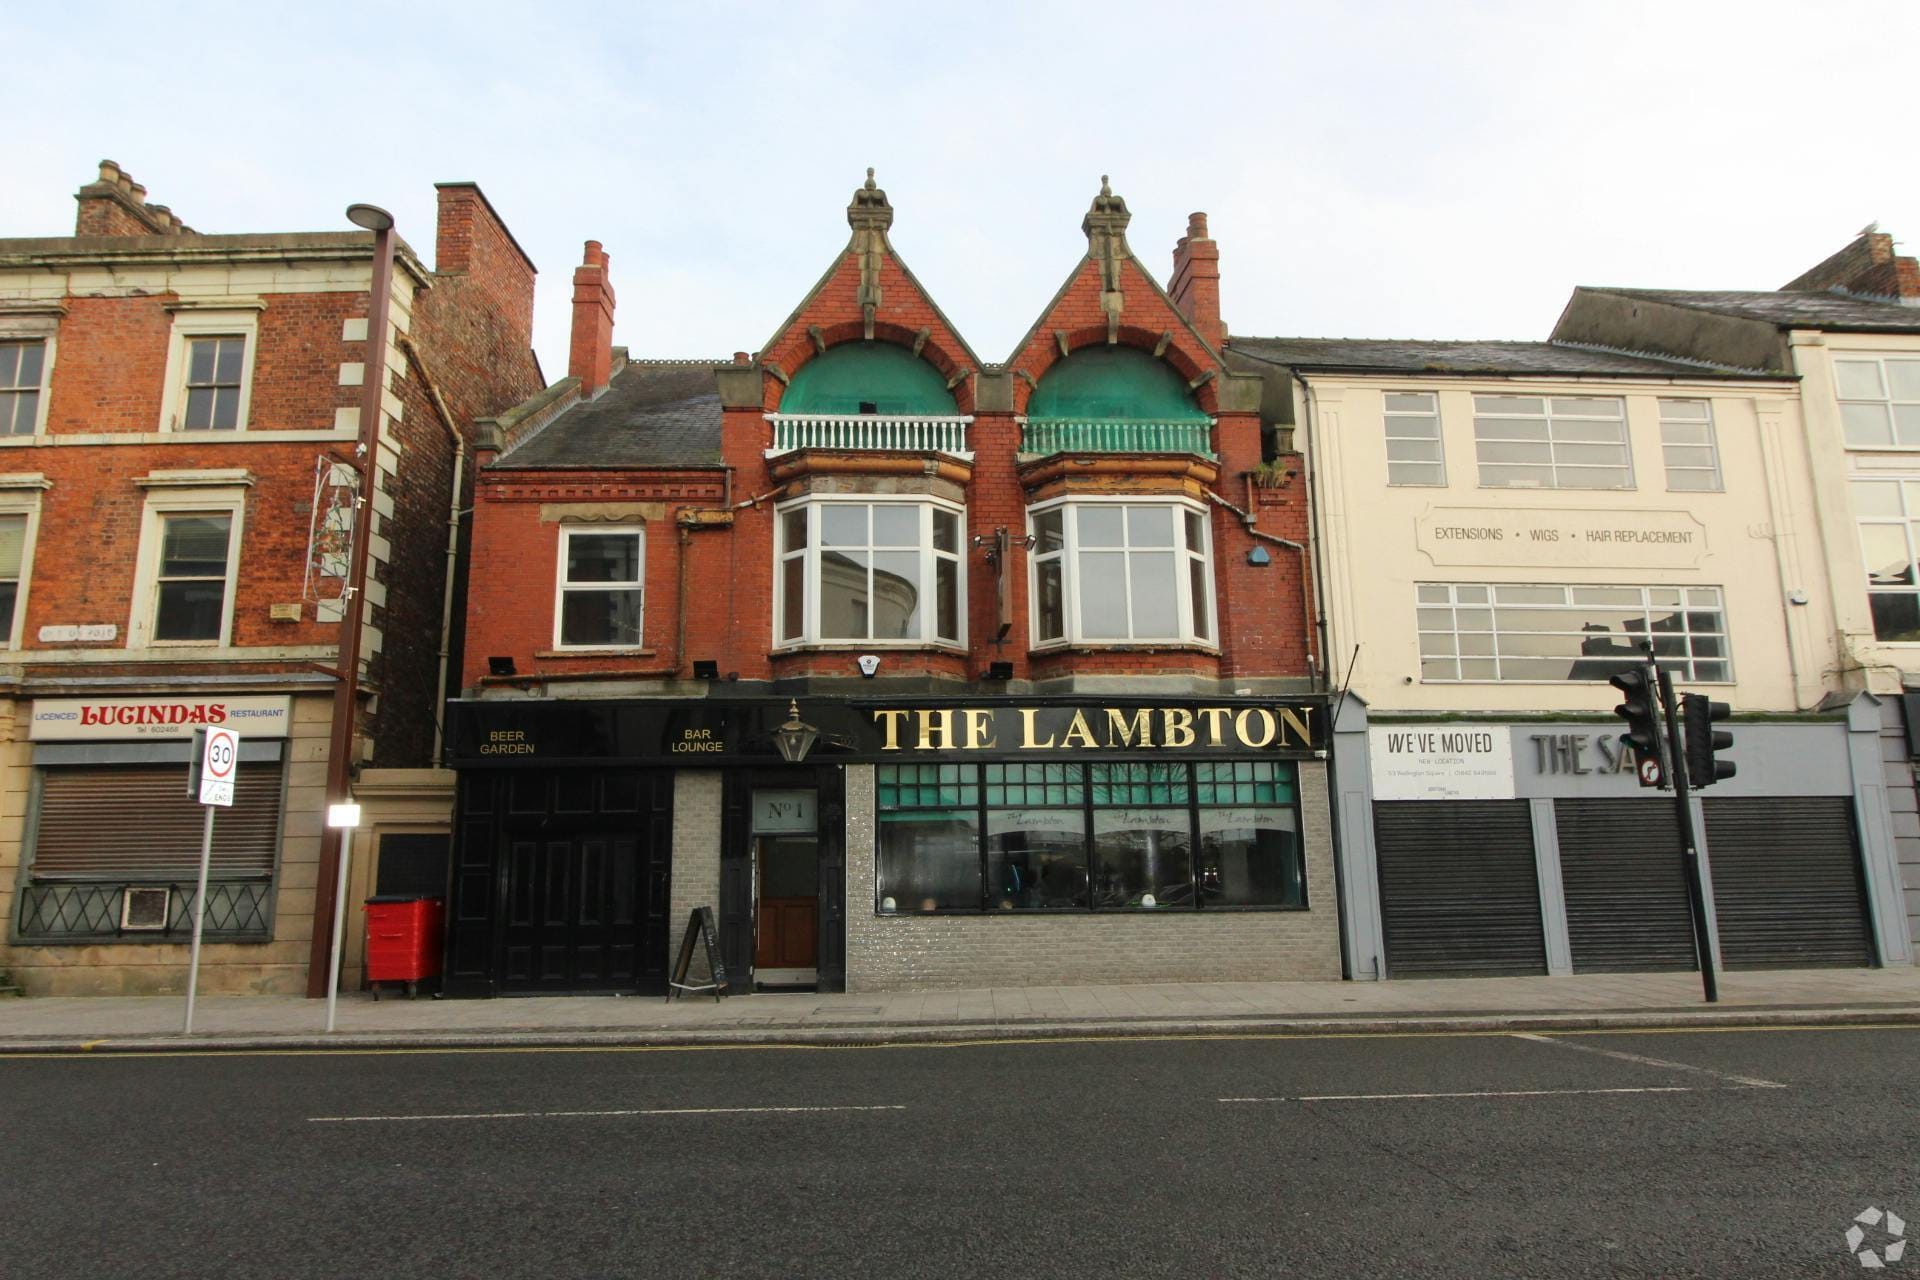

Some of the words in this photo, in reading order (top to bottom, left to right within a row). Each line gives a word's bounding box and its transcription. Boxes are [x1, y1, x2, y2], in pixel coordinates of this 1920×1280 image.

[1435, 528, 1504, 541] EXTENSIONS
[1530, 530, 1559, 542] WIGS
[1586, 530, 1612, 542] HAIR
[1614, 531, 1693, 544] REPLACEMENT
[35, 712, 78, 720] LICENCED
[230, 709, 284, 718] RESTAURANT
[684, 729, 711, 739] BAR
[874, 709, 997, 750] THE
[1018, 708, 1313, 748] LAMBTON
[490, 731, 525, 741] BEER
[480, 743, 535, 754] GARDEN
[672, 741, 724, 752] LOUNGE
[1388, 733, 1436, 753] WE'VE
[1441, 733, 1492, 753] MOVED
[212, 745, 230, 764] 30
[1530, 734, 1593, 775] THE
